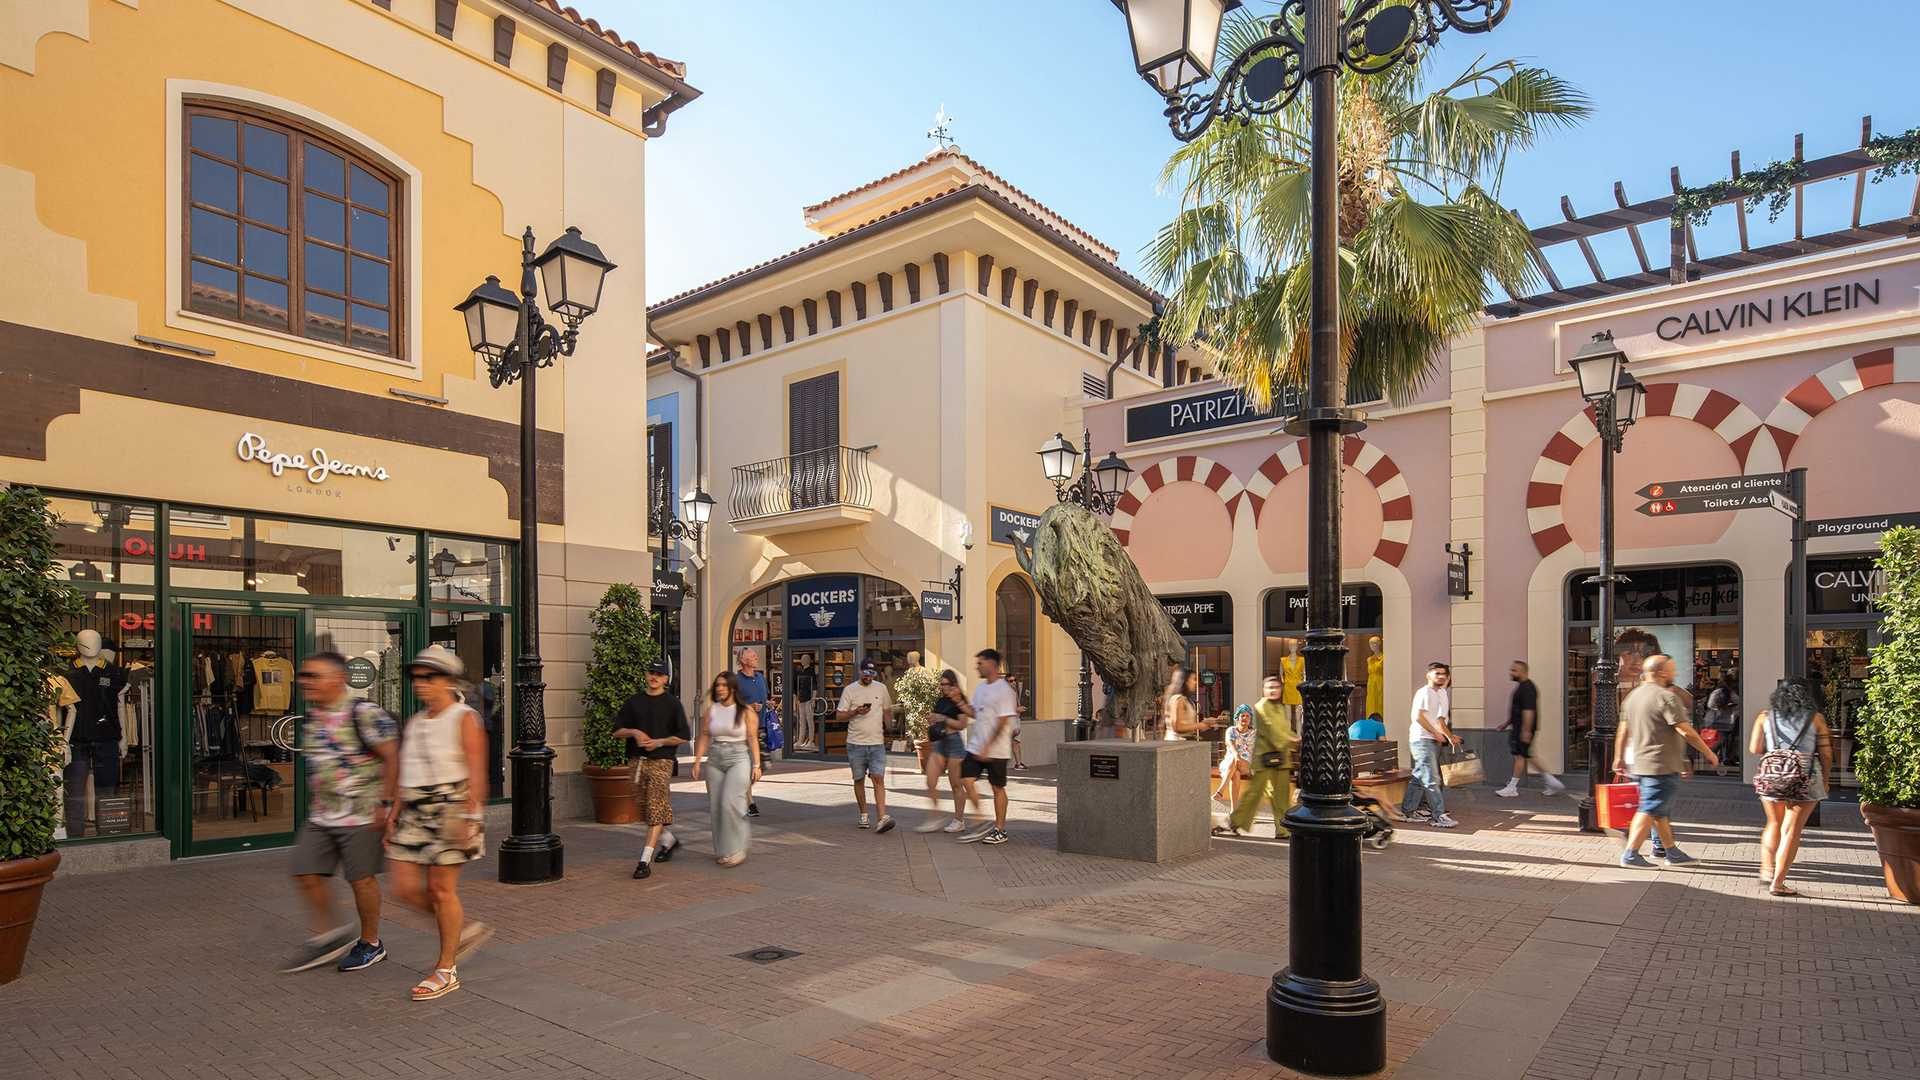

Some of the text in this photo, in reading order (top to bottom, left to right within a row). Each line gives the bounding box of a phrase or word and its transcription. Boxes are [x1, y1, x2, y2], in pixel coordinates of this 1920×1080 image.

[1656, 278, 1880, 341] CALVIN KLEIN
[238, 432, 390, 483] Pepe Jeans
[1679, 477, 1782, 494] Atención al cliente
[1749, 495, 1769, 504] Ase
[1817, 519, 1888, 533] Playground
[791, 590, 855, 607] DOCKERS
[924, 597, 950, 605] DOCKERS
[1194, 603, 1215, 614] PEPE
